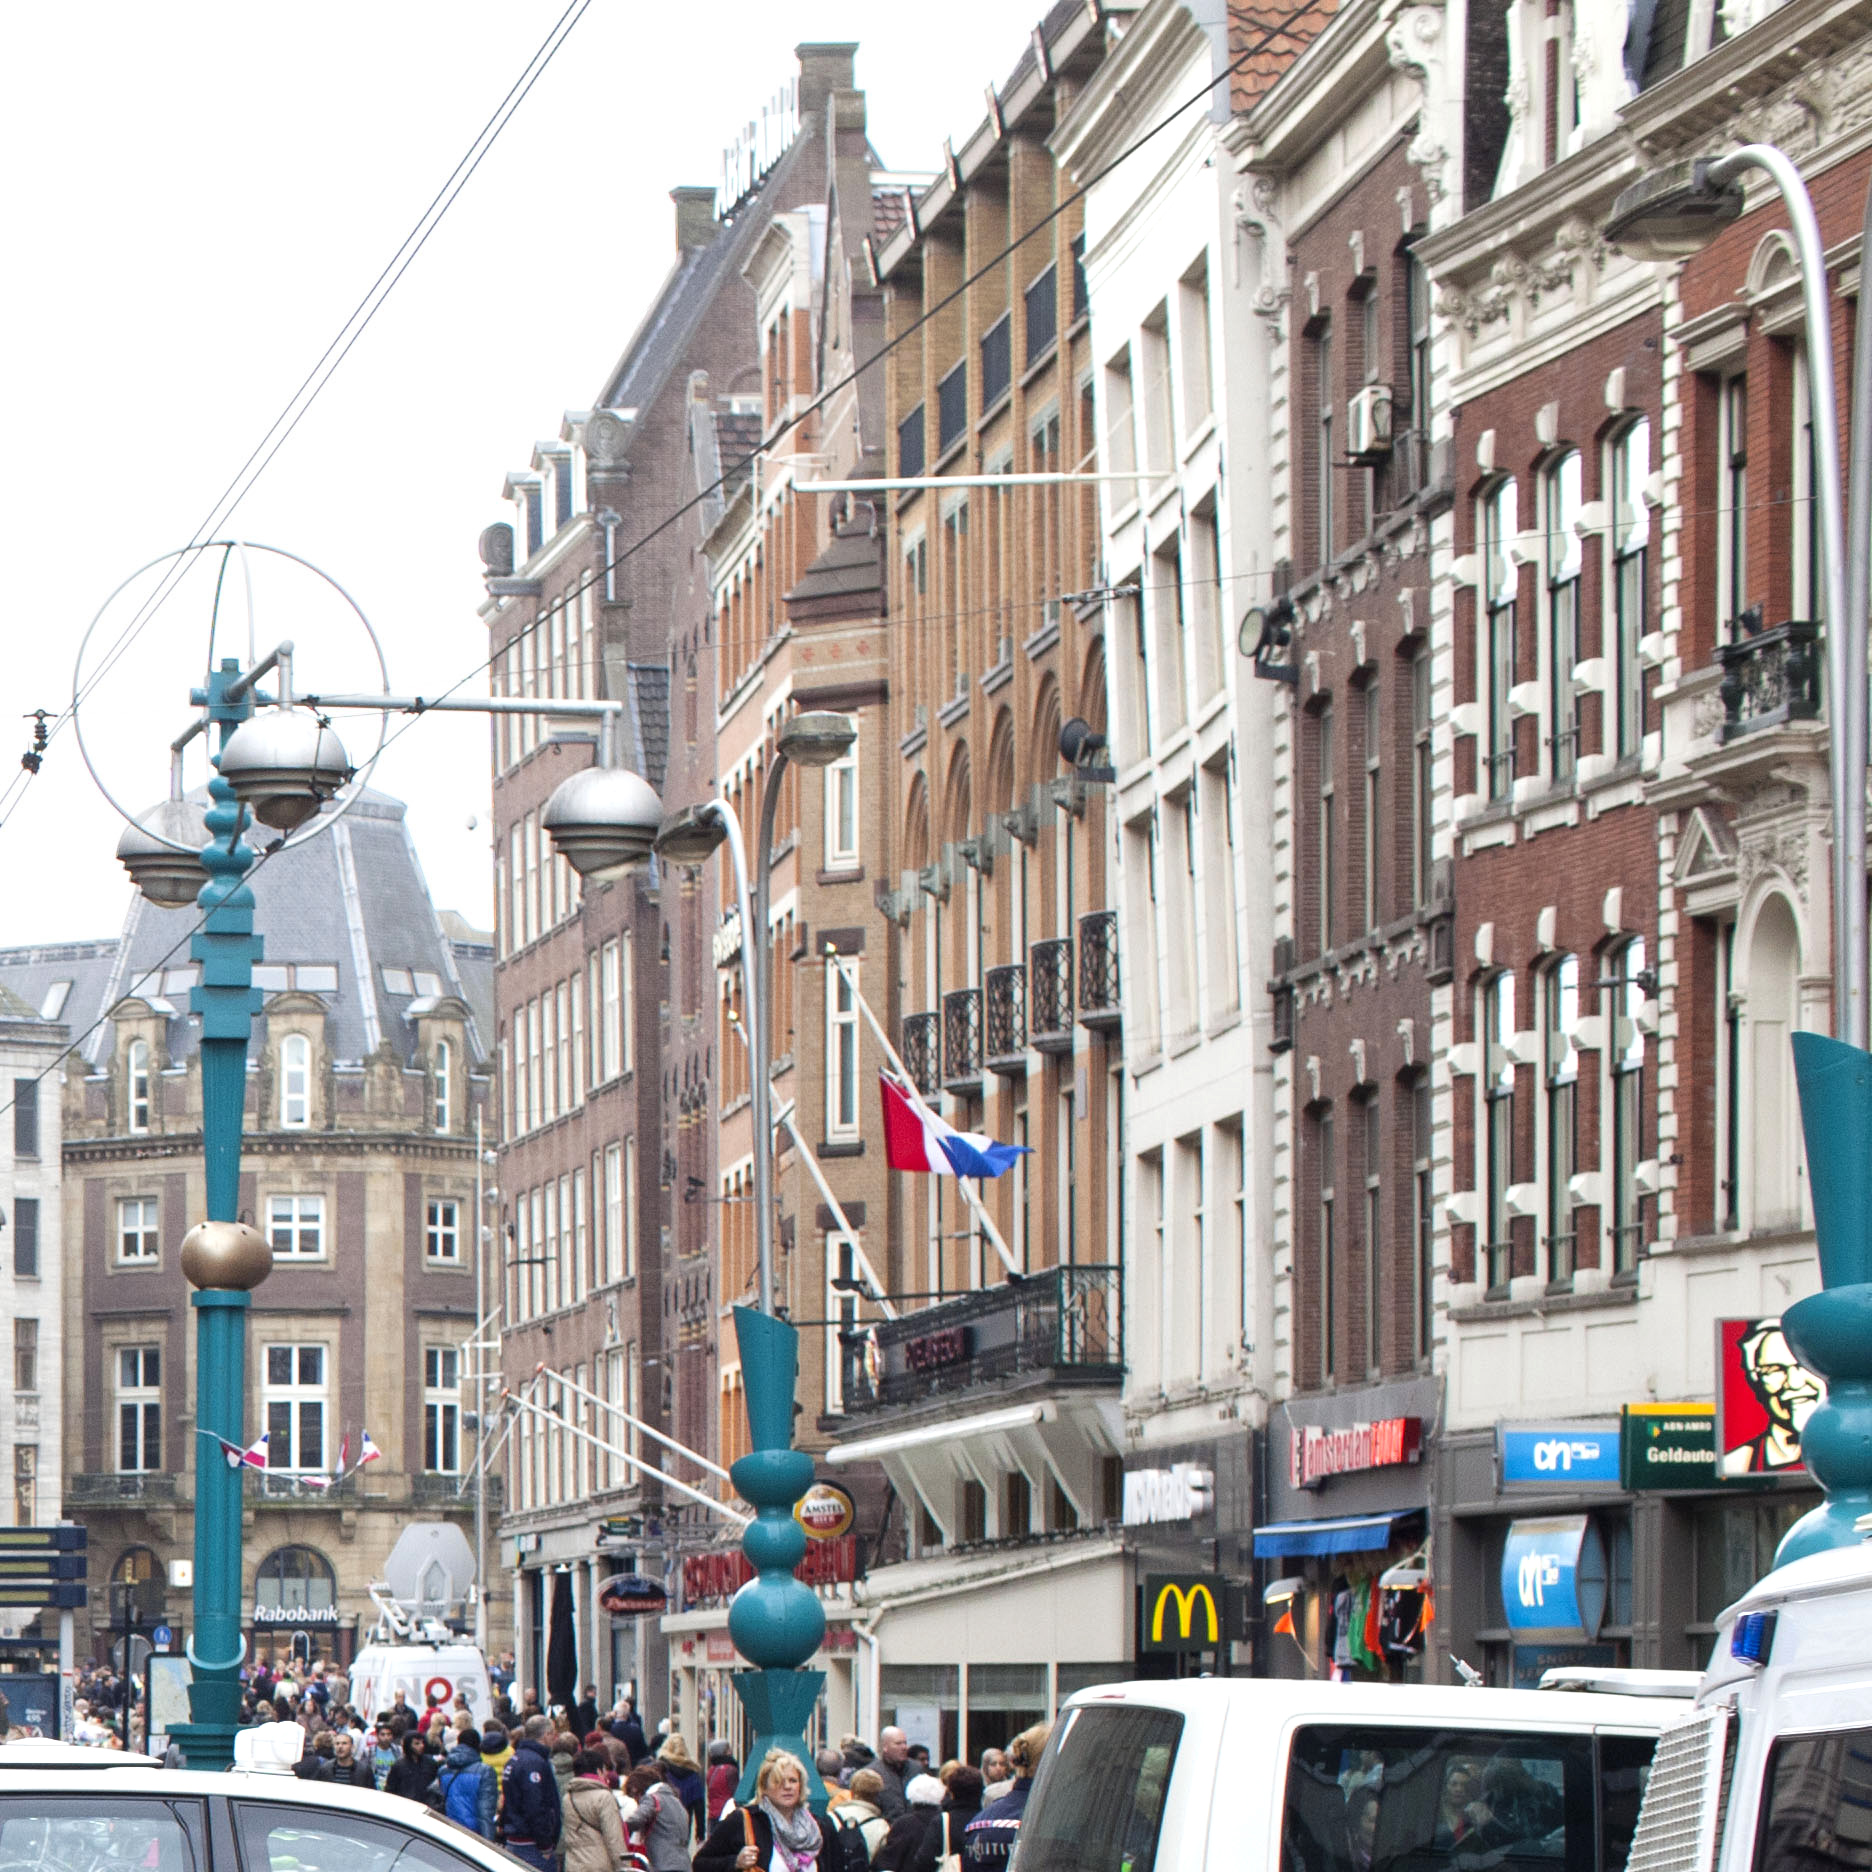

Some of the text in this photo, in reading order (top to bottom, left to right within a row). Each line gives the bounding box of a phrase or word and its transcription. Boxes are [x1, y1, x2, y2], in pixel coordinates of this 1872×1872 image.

[1646, 1445, 1717, 1464] Geldauto
[805, 1501, 845, 1515] AMSTEL
[254, 1604, 339, 1622] Rabobank
[392, 1676, 479, 1705] NOS
